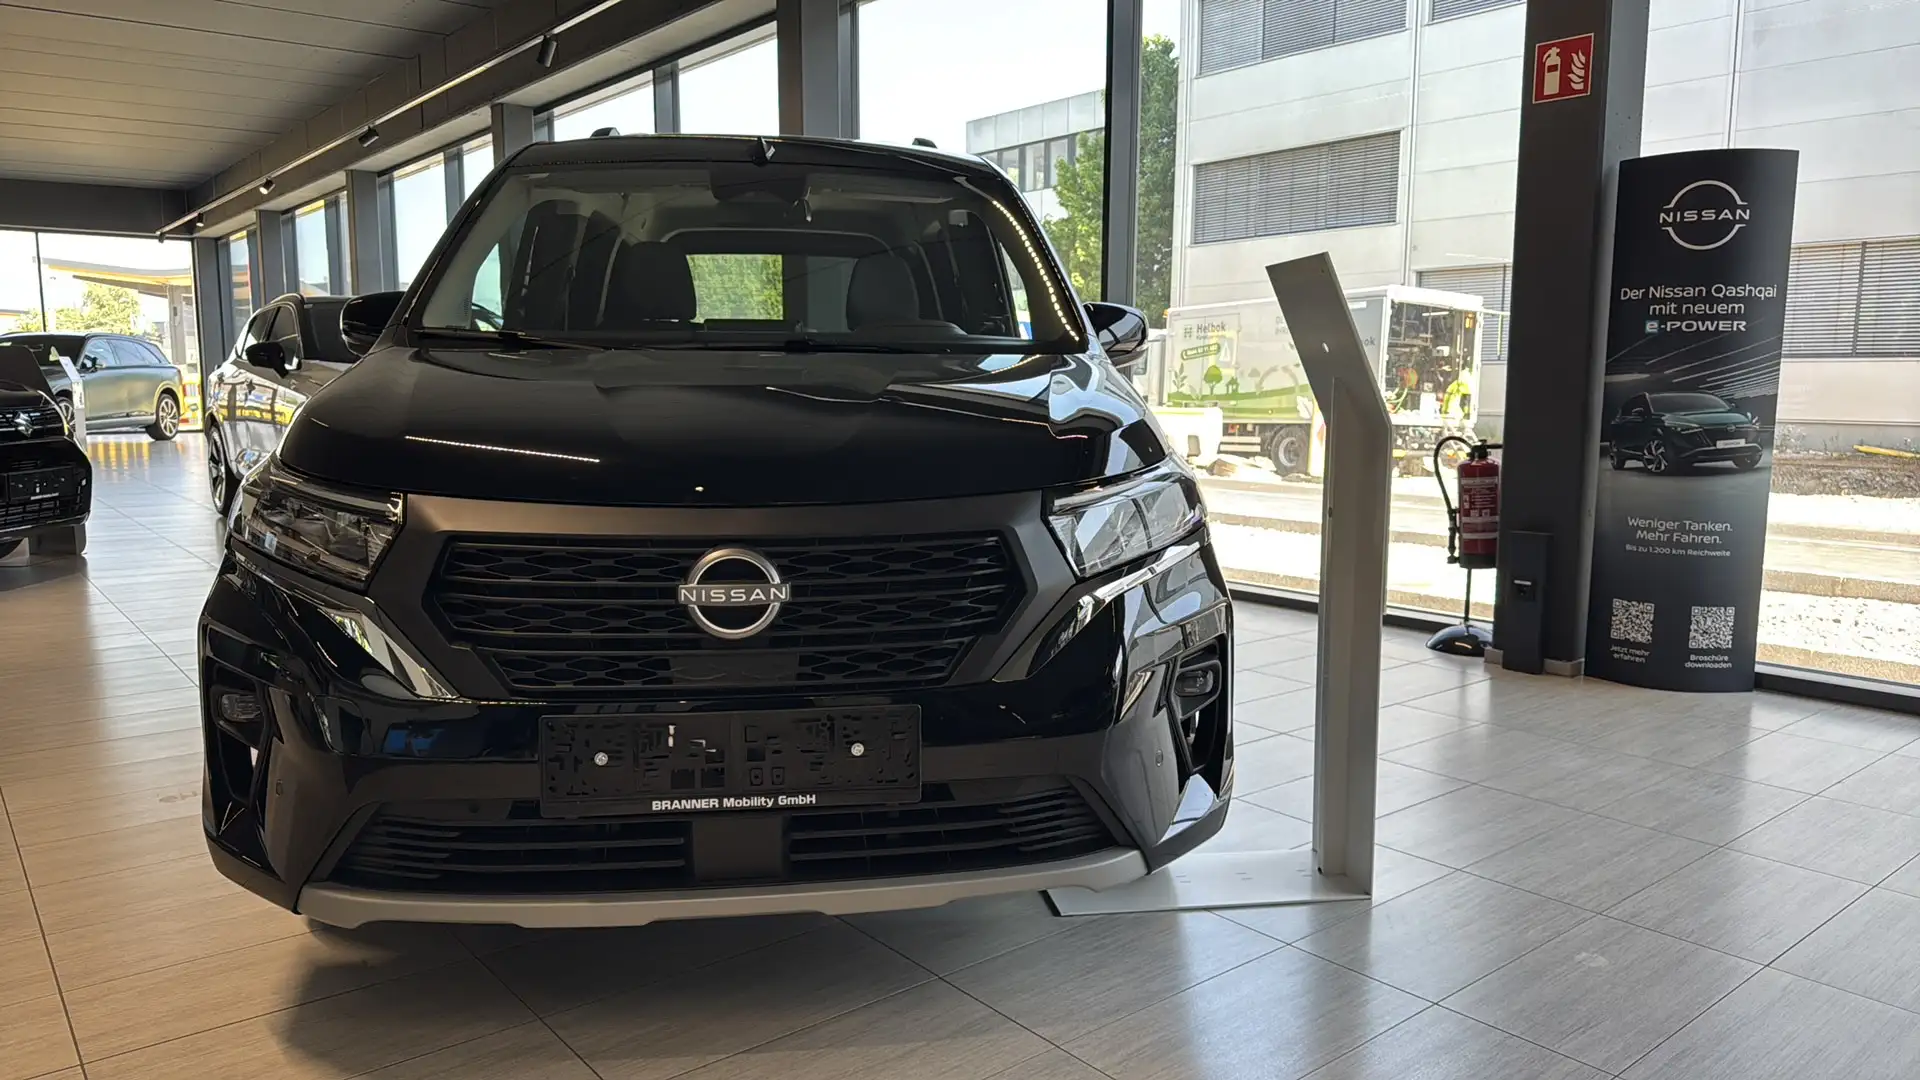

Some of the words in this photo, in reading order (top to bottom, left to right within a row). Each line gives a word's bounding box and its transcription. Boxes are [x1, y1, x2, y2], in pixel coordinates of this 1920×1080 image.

[1659, 208, 1750, 223] NISSAN
[1620, 287, 1645, 300] Der
[1649, 285, 1706, 298] Nissan
[1711, 283, 1777, 300] Qashqai
[1649, 302, 1677, 315] mit
[1682, 302, 1745, 314] neuem
[1196, 322, 1226, 333] Helbok
[1645, 320, 1747, 332] e-POWER
[1627, 516, 1680, 531] Weniger
[1683, 519, 1733, 532] Tanken.
[1636, 530, 1670, 542] Mehr
[1672, 532, 1722, 544] Fahren.
[1625, 543, 1637, 552] Bis
[1687, 549, 1731, 557] Reichweite
[681, 587, 786, 602] NISSAN
[1613, 653, 1646, 663] erfahren
[1629, 648, 1650, 656] mehr
[1690, 654, 1729, 662] Broschüre
[1685, 661, 1732, 669] downloaden
[651, 798, 719, 811] BRANNER
[723, 796, 774, 808] Mobility
[778, 794, 816, 806] GmbH
